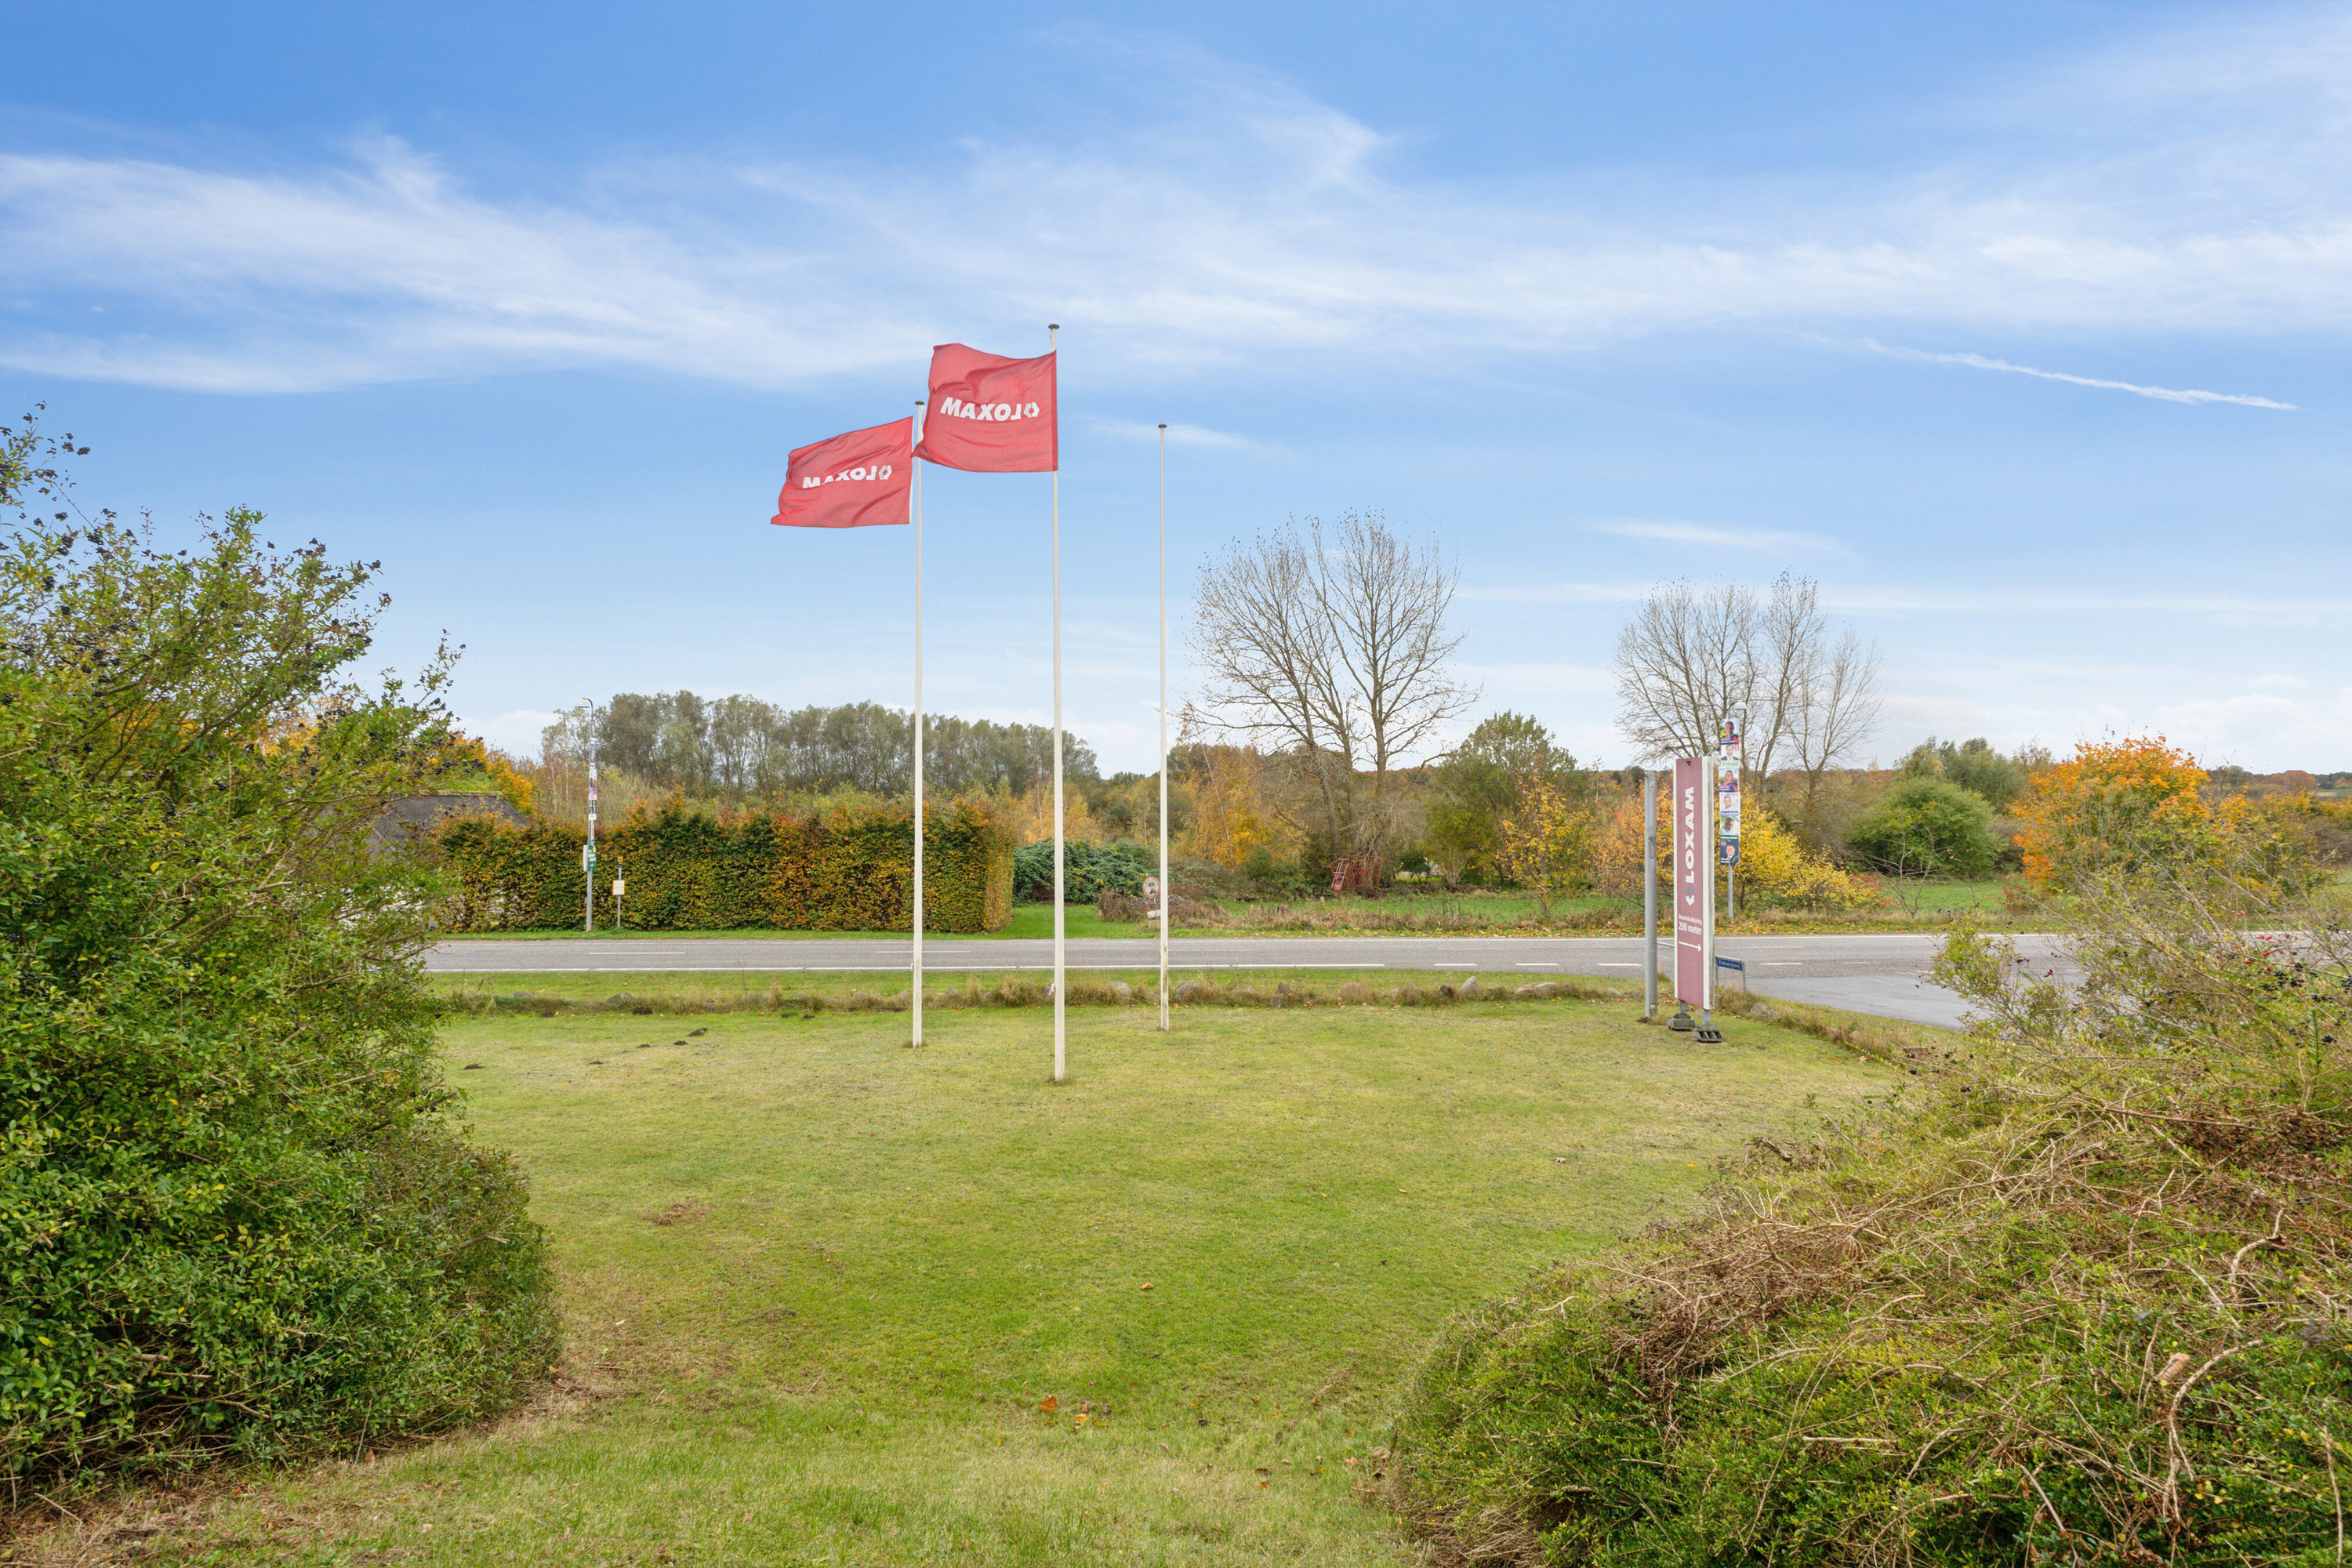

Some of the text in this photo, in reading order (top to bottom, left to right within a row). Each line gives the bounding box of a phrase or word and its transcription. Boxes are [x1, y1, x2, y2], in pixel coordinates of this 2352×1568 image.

[1686, 786, 1694, 884] LOXAM
[1679, 921, 1702, 935] 200 meter
